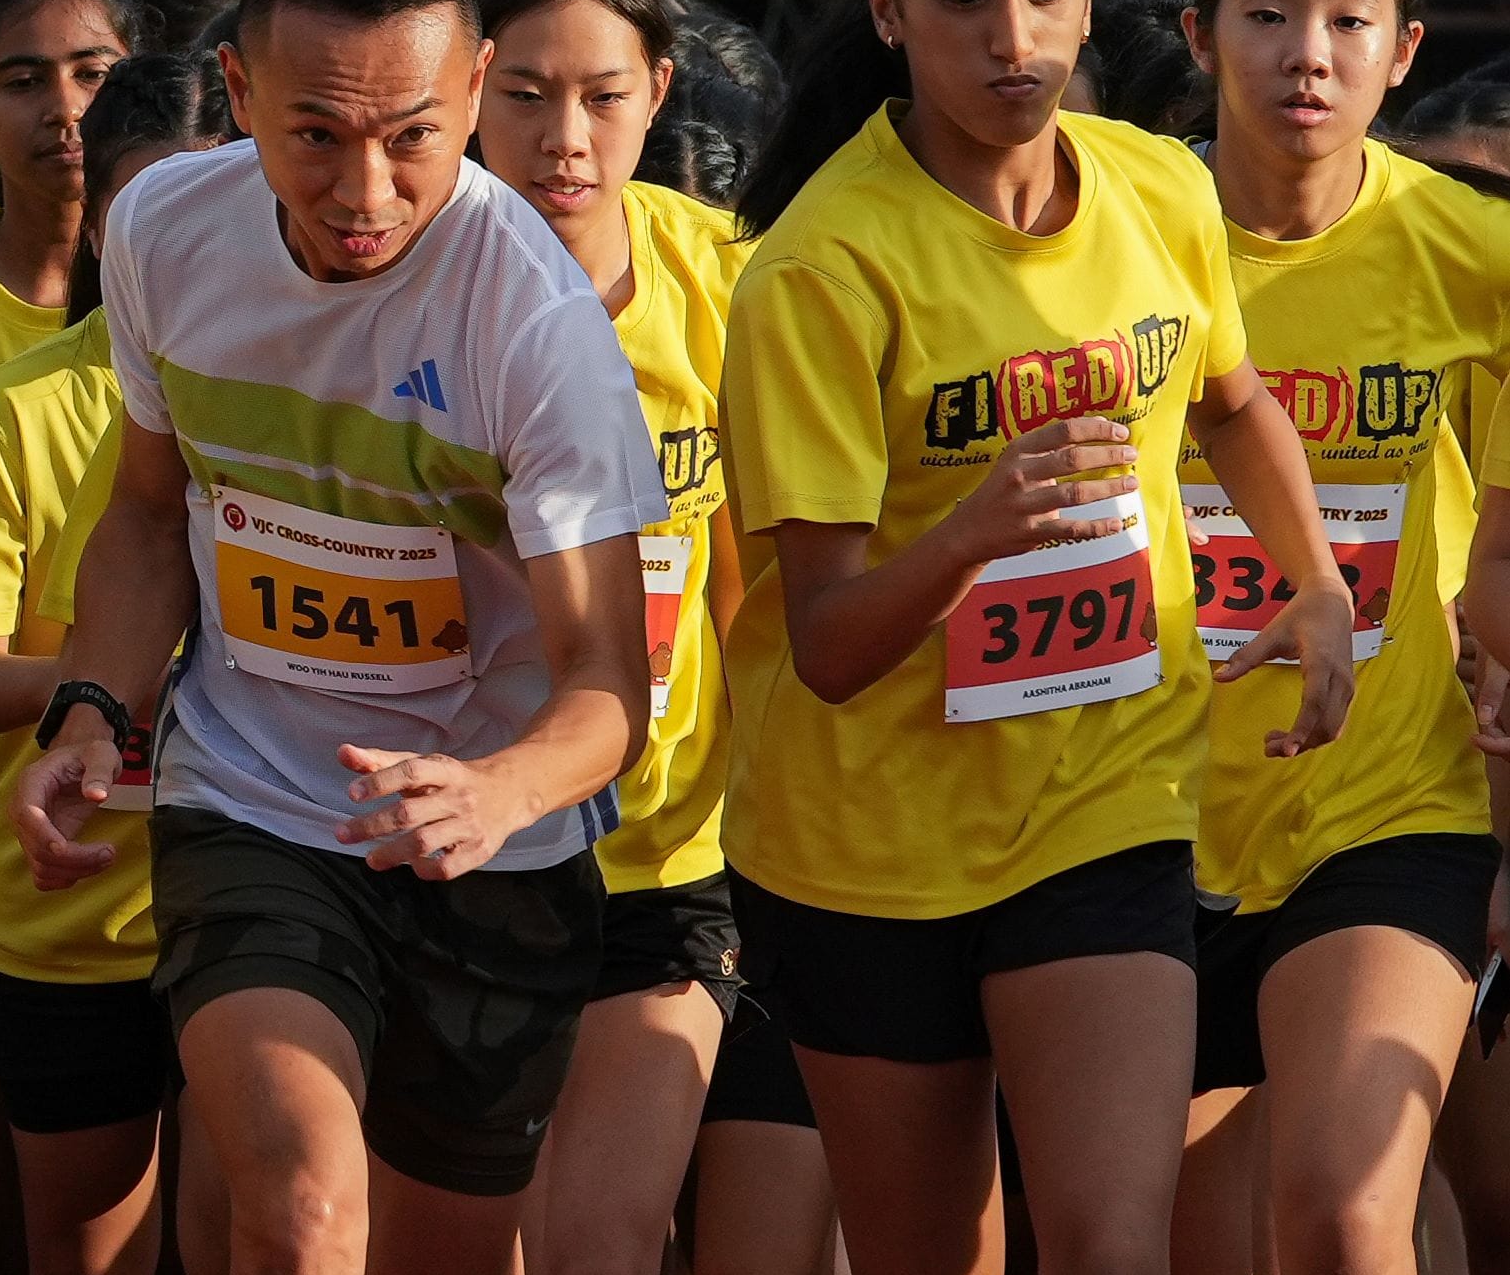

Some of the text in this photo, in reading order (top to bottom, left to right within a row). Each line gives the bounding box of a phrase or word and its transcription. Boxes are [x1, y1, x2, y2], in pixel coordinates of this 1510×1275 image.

[662, 428, 719, 491] UP
[920, 451, 991, 468] victoria
[1321, 439, 1380, 461] united
[1384, 447, 1403, 459] as
[1192, 506, 1219, 518] VJC
[1354, 508, 1389, 522] 2025
[251, 516, 437, 561] VJC CROSS-COUNTRY 2025
[250, 575, 419, 648] 1541
[981, 578, 1136, 664] 3797
[287, 661, 311, 674] WOO
[328, 668, 350, 679] HAU
[350, 671, 394, 682] RUSSELL
[1022, 676, 1112, 700] AASHITHA ABRAHAM
